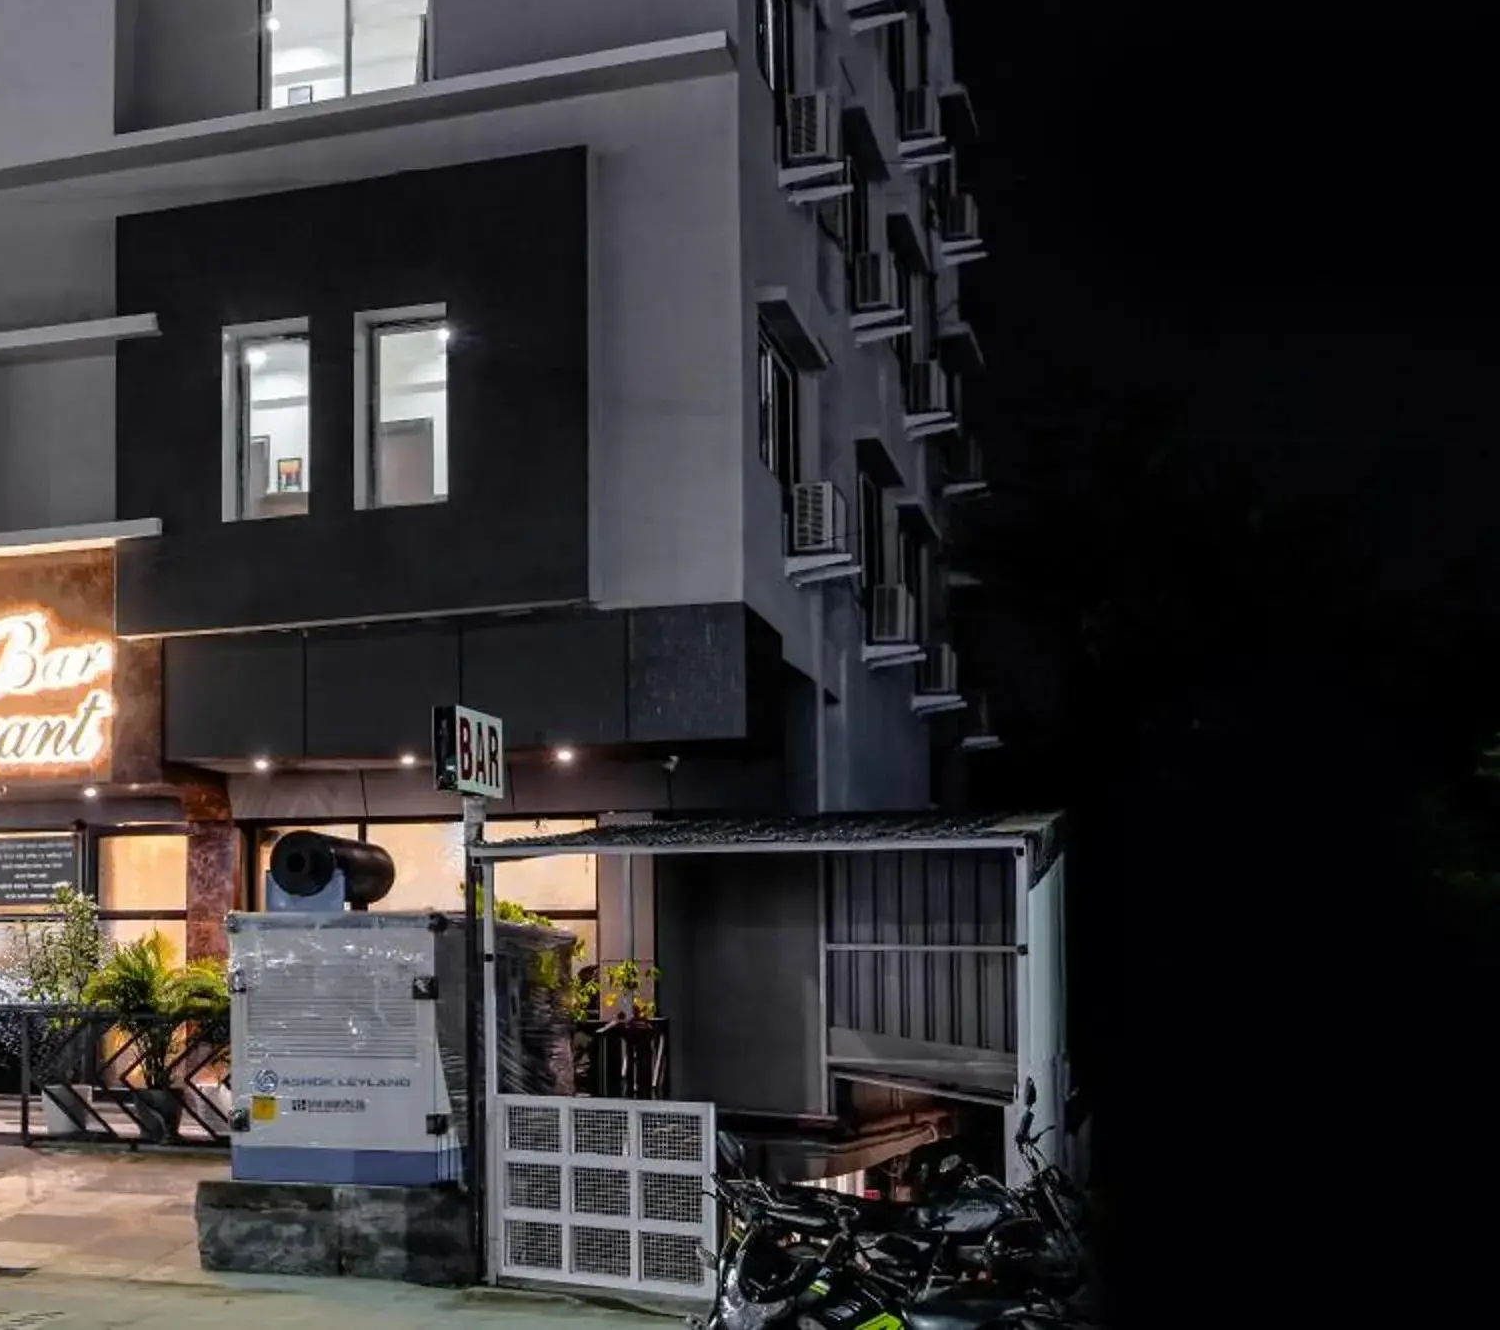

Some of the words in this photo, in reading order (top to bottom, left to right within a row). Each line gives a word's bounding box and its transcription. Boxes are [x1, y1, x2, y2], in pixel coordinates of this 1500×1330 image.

[459, 716, 499, 788] BAR
[280, 1078, 334, 1088] ASHOK
[337, 1077, 412, 1088] LEYLAND
